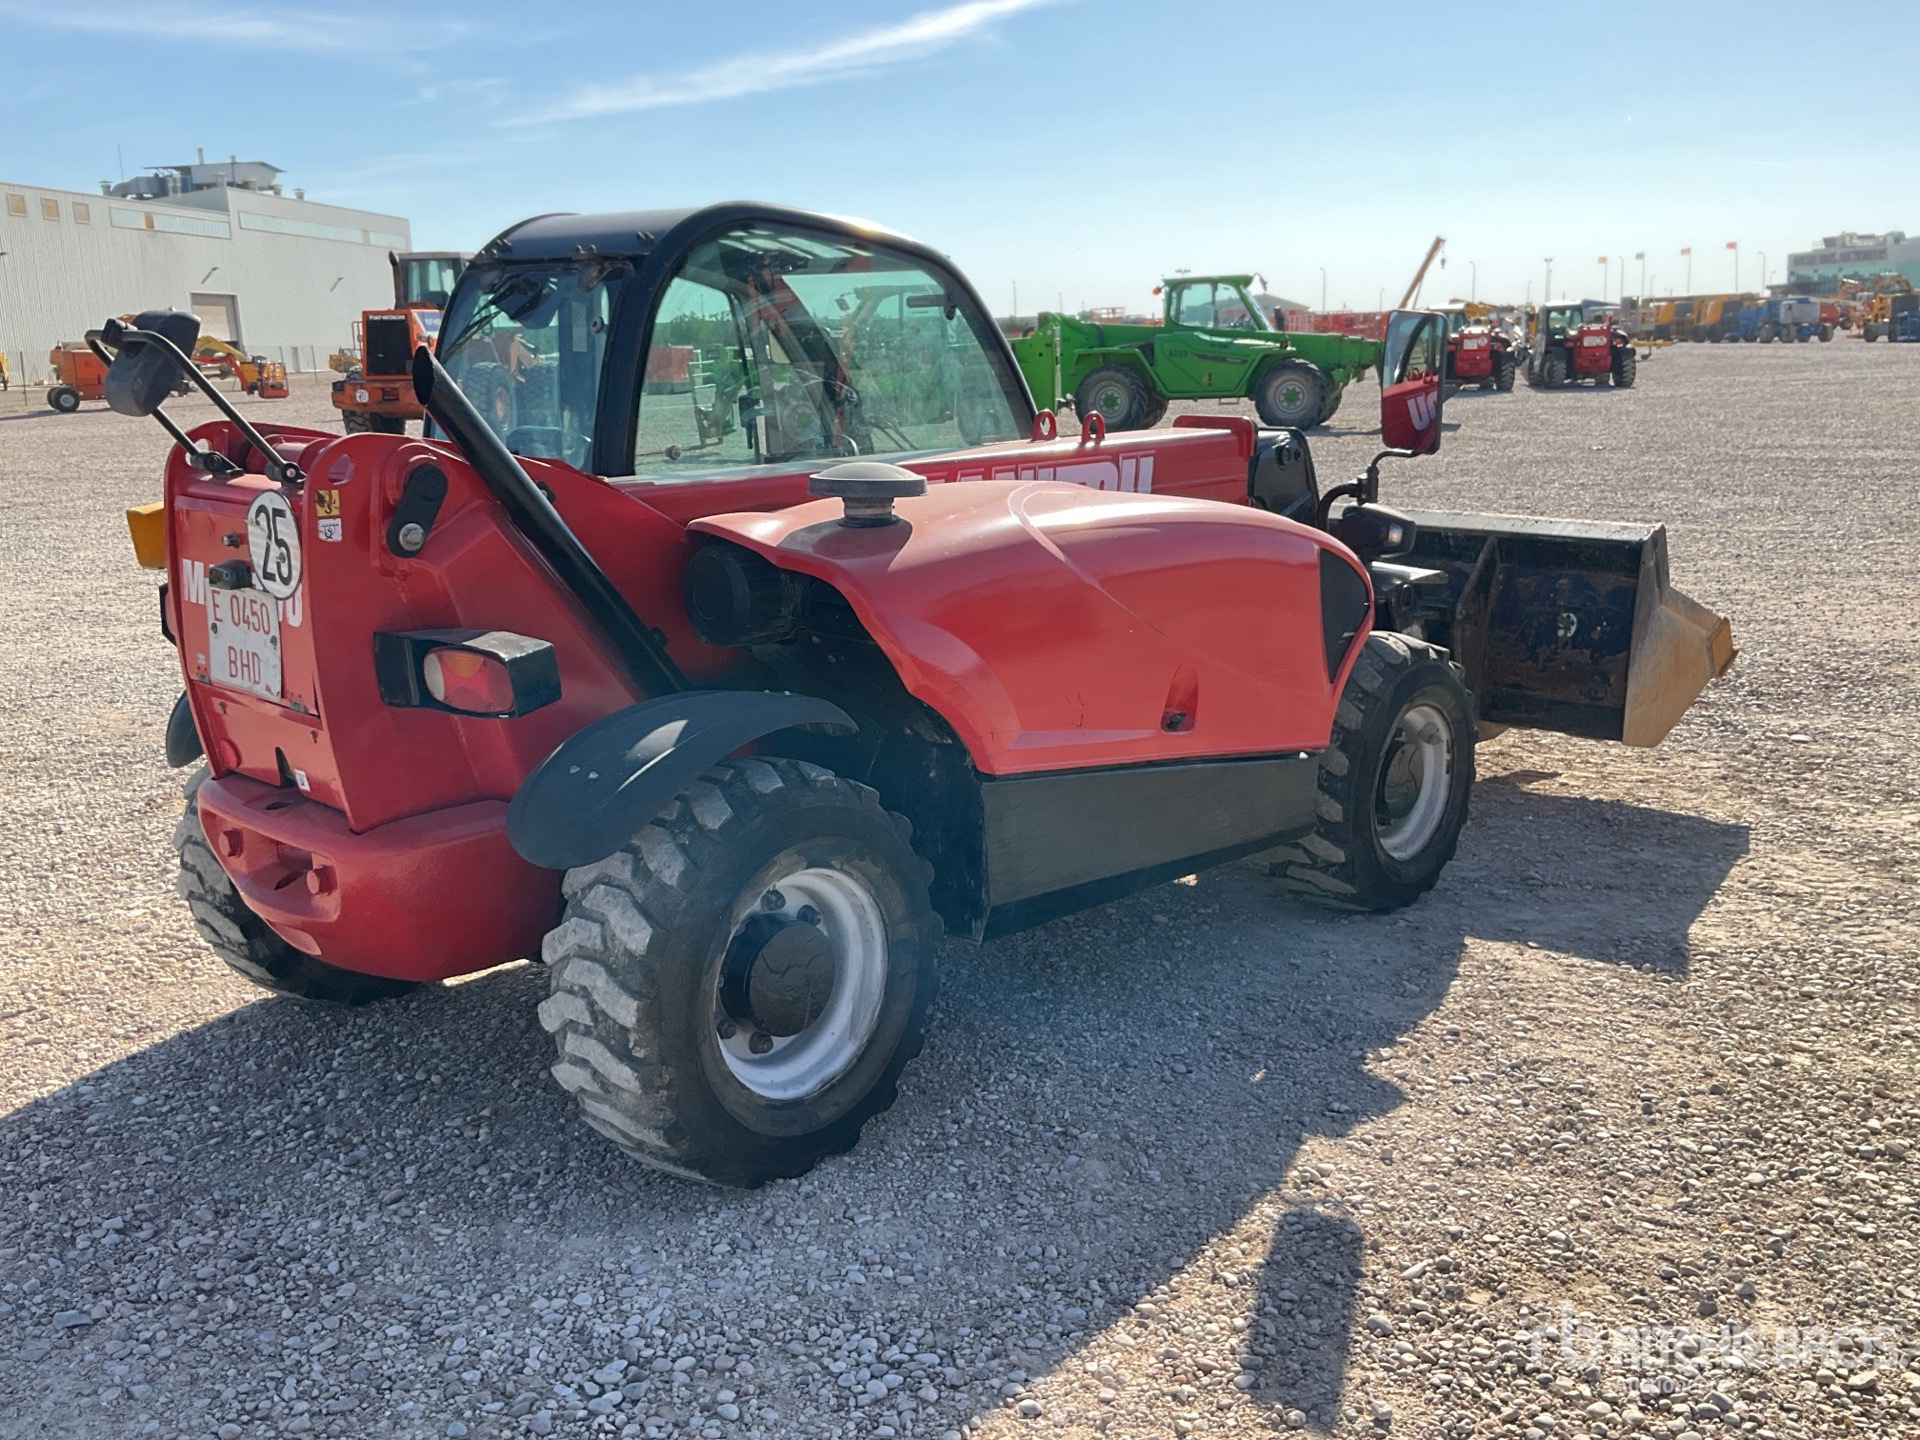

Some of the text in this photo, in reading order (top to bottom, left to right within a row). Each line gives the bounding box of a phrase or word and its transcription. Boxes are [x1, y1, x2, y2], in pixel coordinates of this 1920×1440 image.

[254, 504, 293, 586] 25
[212, 590, 223, 623] E
[230, 594, 270, 635] 0450
[227, 645, 261, 685] BHD
